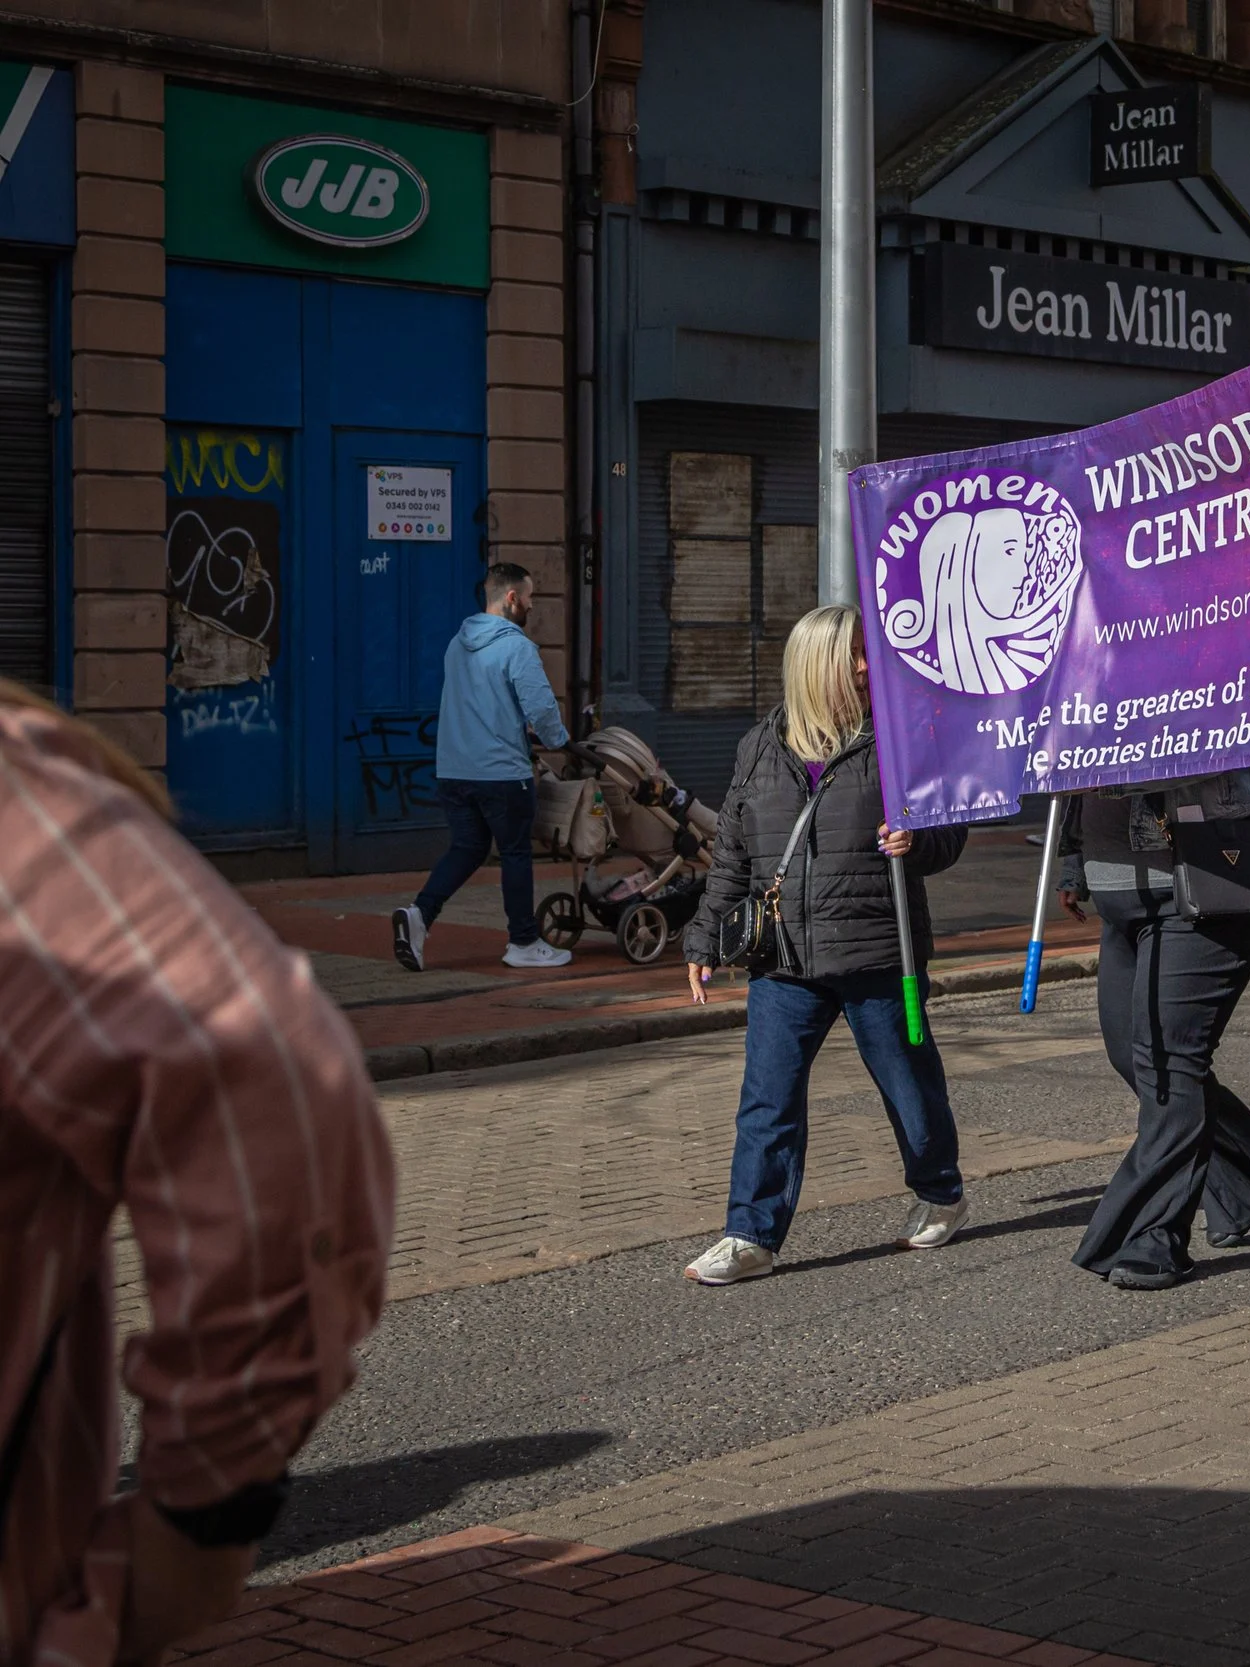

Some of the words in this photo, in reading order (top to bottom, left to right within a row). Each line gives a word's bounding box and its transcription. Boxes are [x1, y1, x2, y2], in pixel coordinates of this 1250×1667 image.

[1109, 102, 1176, 132] Jean
[1104, 139, 1184, 172] Millar
[281, 159, 399, 220] JJB
[976, 265, 1092, 340] Jean
[1106, 281, 1233, 355] Millar
[387, 472, 403, 481] VPS
[612, 462, 627, 476] 48
[378, 486, 417, 497] Secured
[418, 488, 428, 499] by
[430, 489, 447, 498] VPS
[385, 501, 407, 510] 0345
[408, 502, 423, 511] 002
[424, 503, 441, 512] 0142
[879, 474, 1060, 559] women
[1060, 692, 1109, 726] the
[1113, 682, 1217, 732] greatest
[1221, 666, 1248, 705] of
[1056, 736, 1147, 771] stories
[1150, 725, 1202, 759] that
